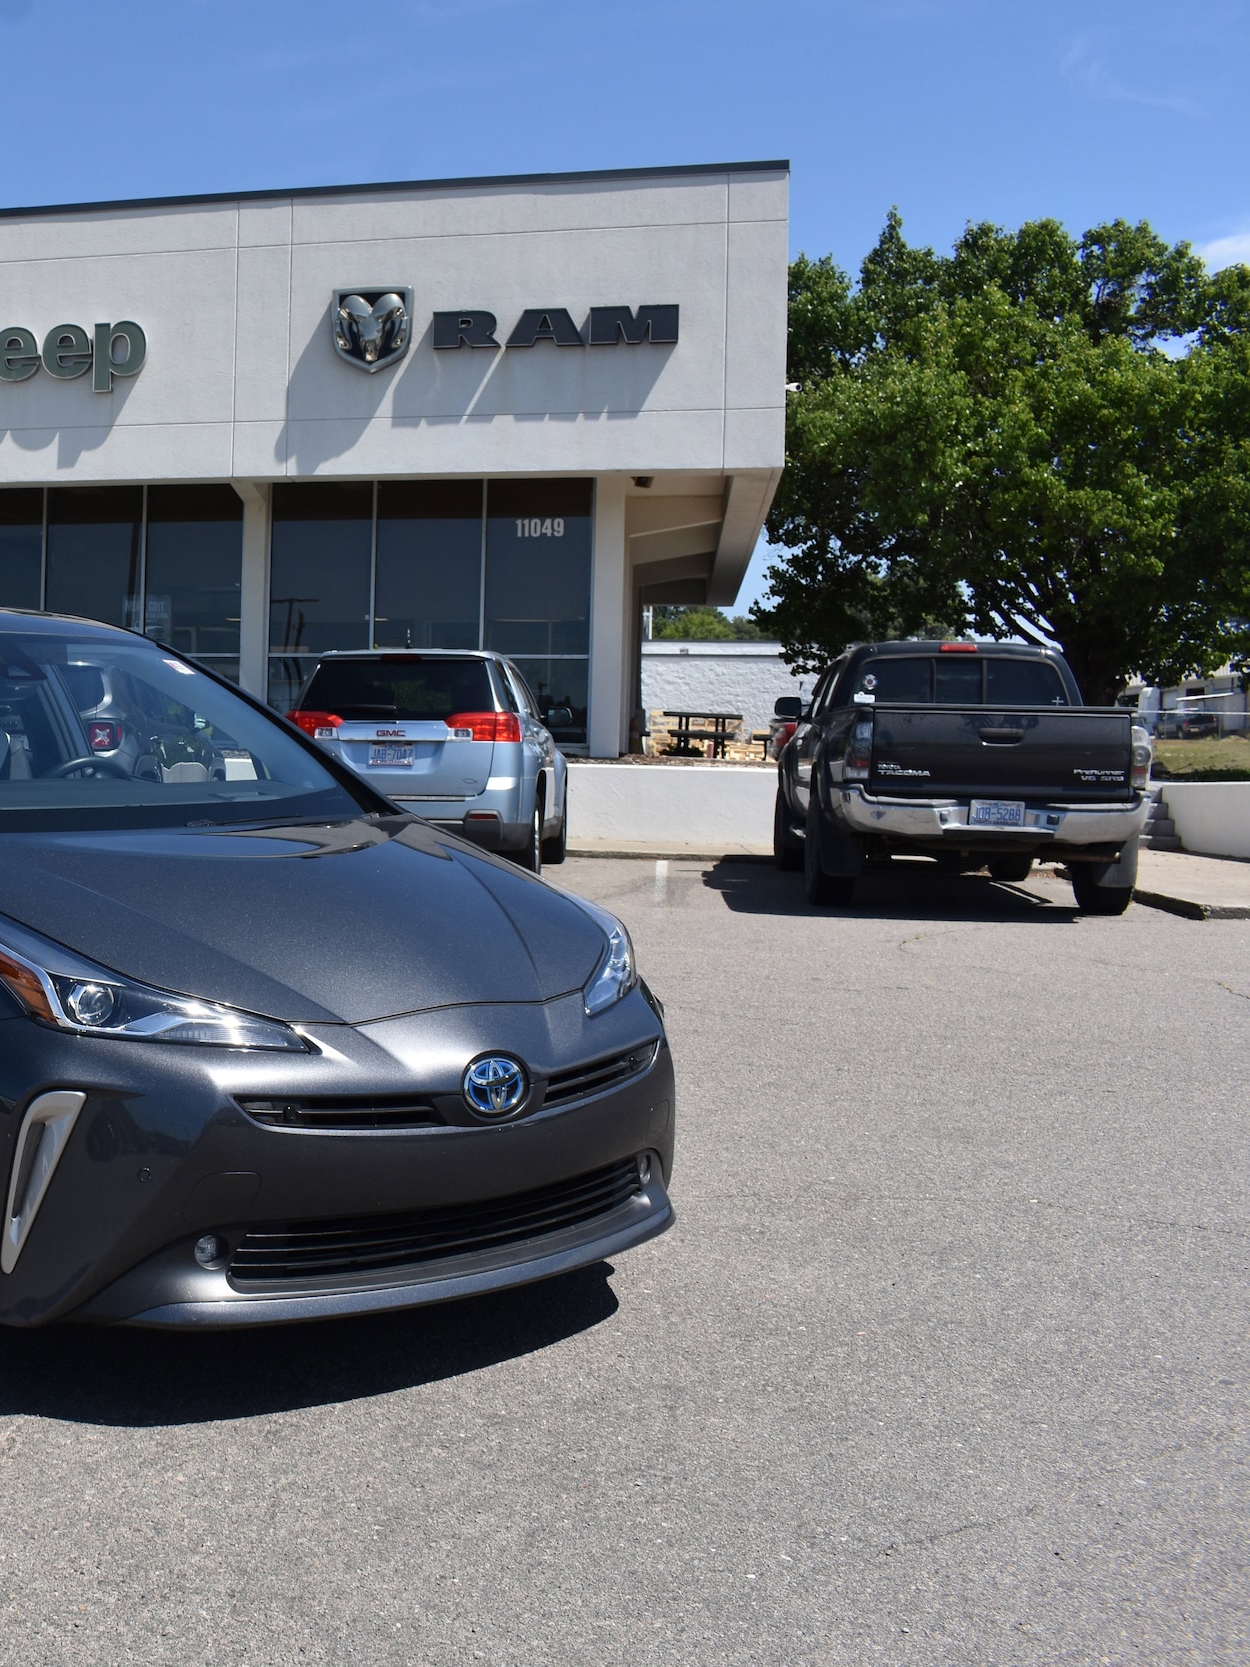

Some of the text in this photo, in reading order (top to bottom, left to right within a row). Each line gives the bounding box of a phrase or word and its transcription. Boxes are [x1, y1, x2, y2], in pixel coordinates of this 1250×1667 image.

[433, 304, 679, 349] RAM
[515, 518, 565, 537] 11049
[376, 729, 406, 738] GMC
[878, 769, 931, 777] TACOMA
